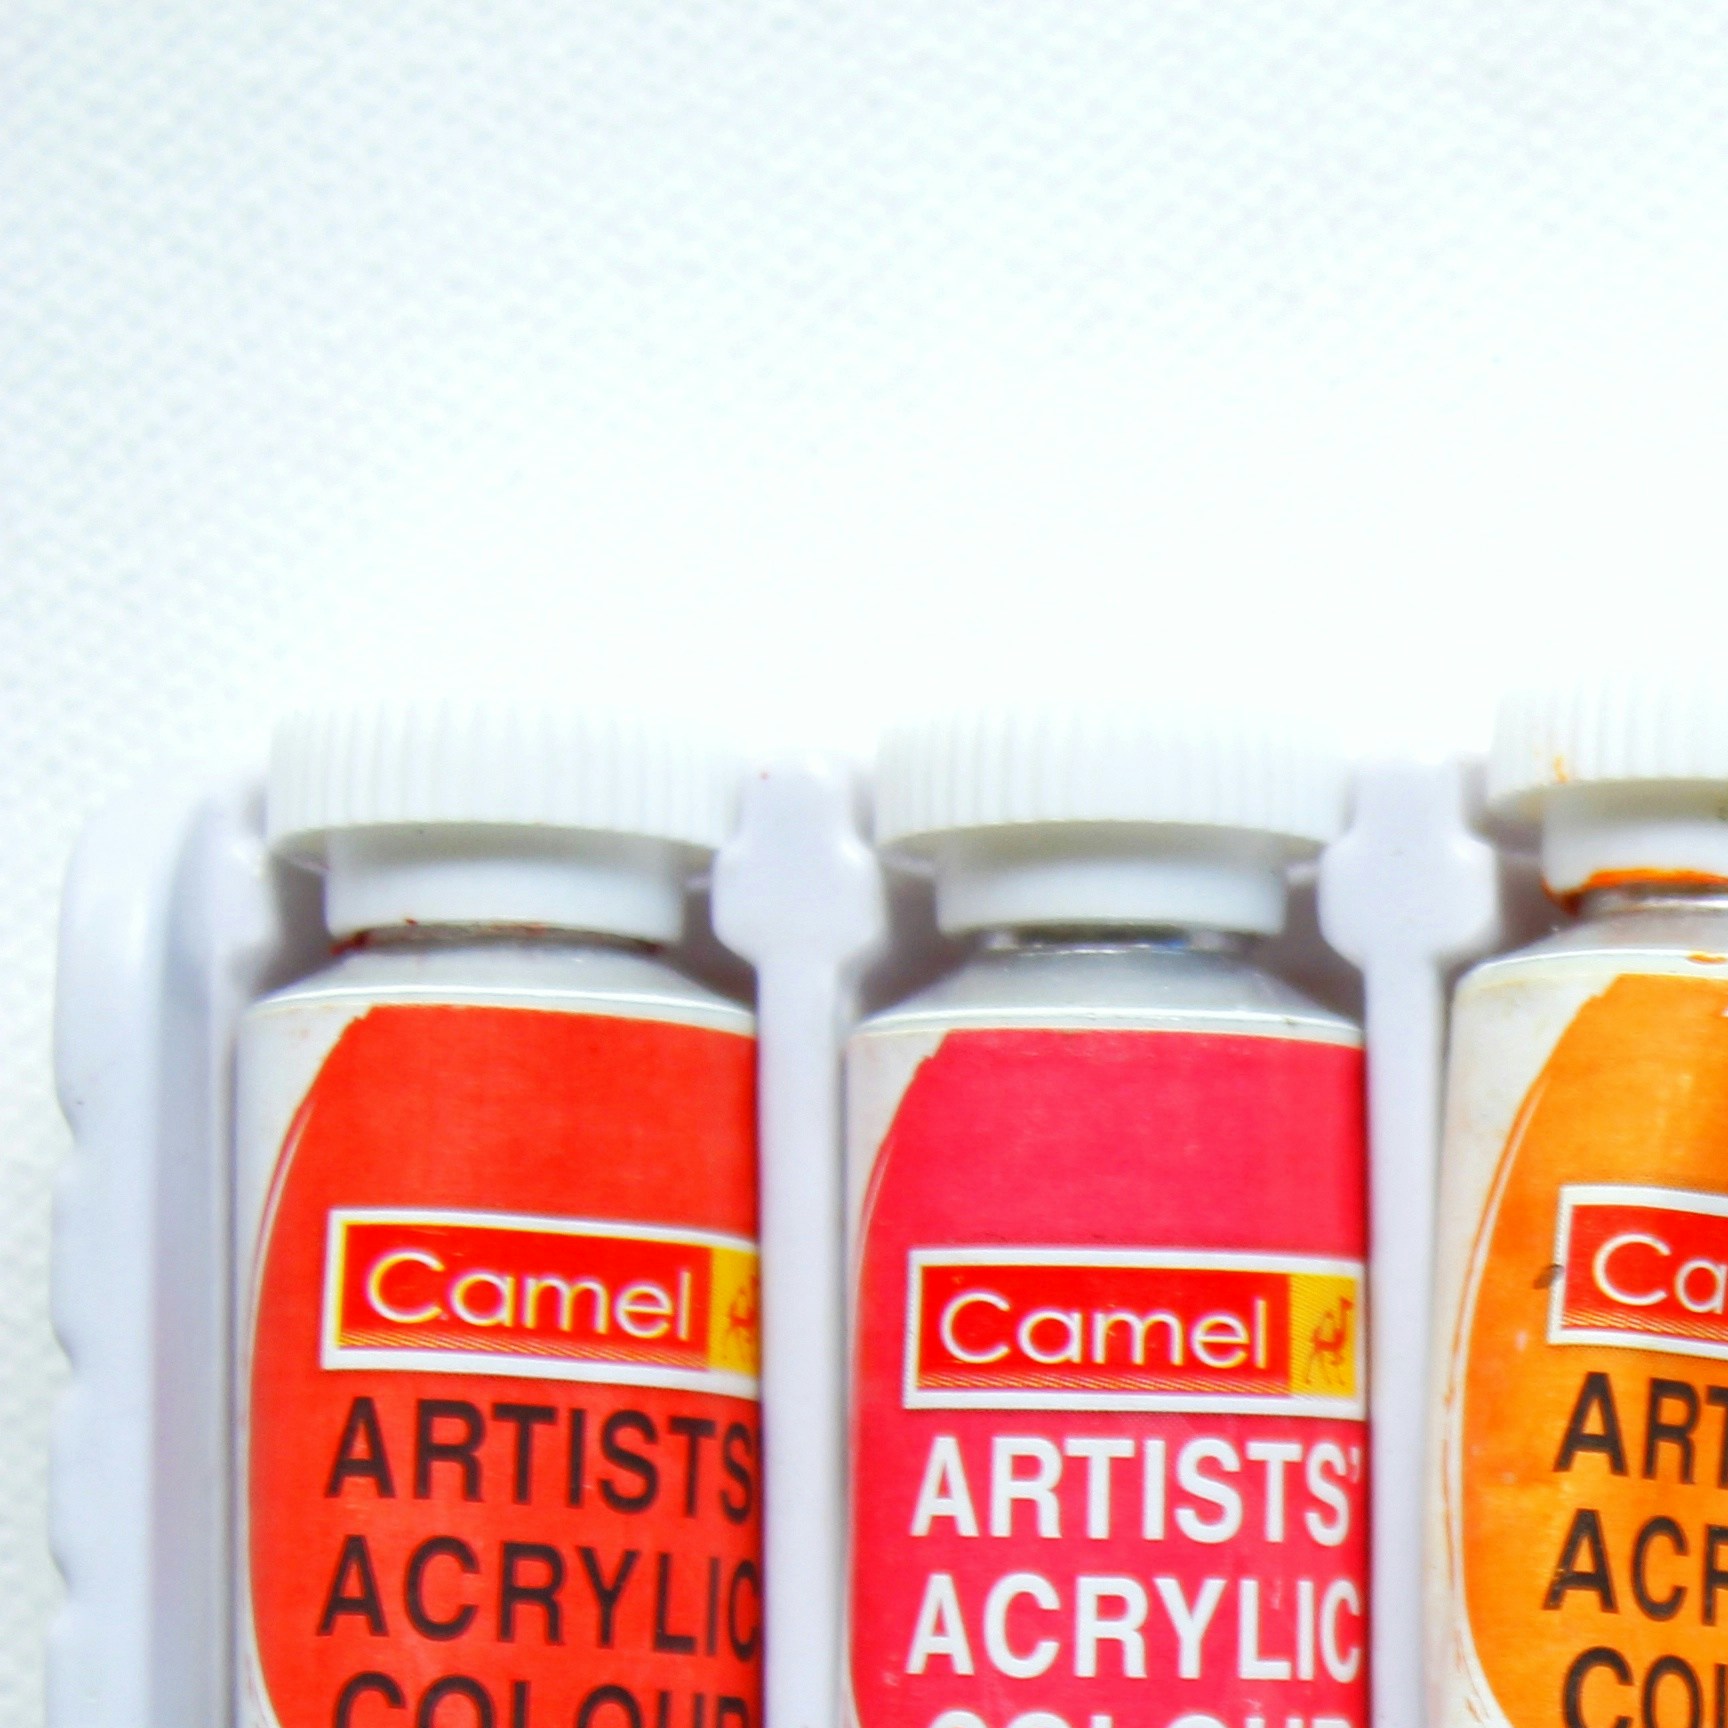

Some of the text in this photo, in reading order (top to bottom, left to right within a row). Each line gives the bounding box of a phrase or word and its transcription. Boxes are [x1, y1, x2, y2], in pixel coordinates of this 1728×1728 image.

[366, 1250, 692, 1342] Camel
[939, 1291, 1269, 1370] Camel
[316, 1534, 758, 1661] ACRYLIC
[905, 1571, 1361, 1684] ACRYLIC
